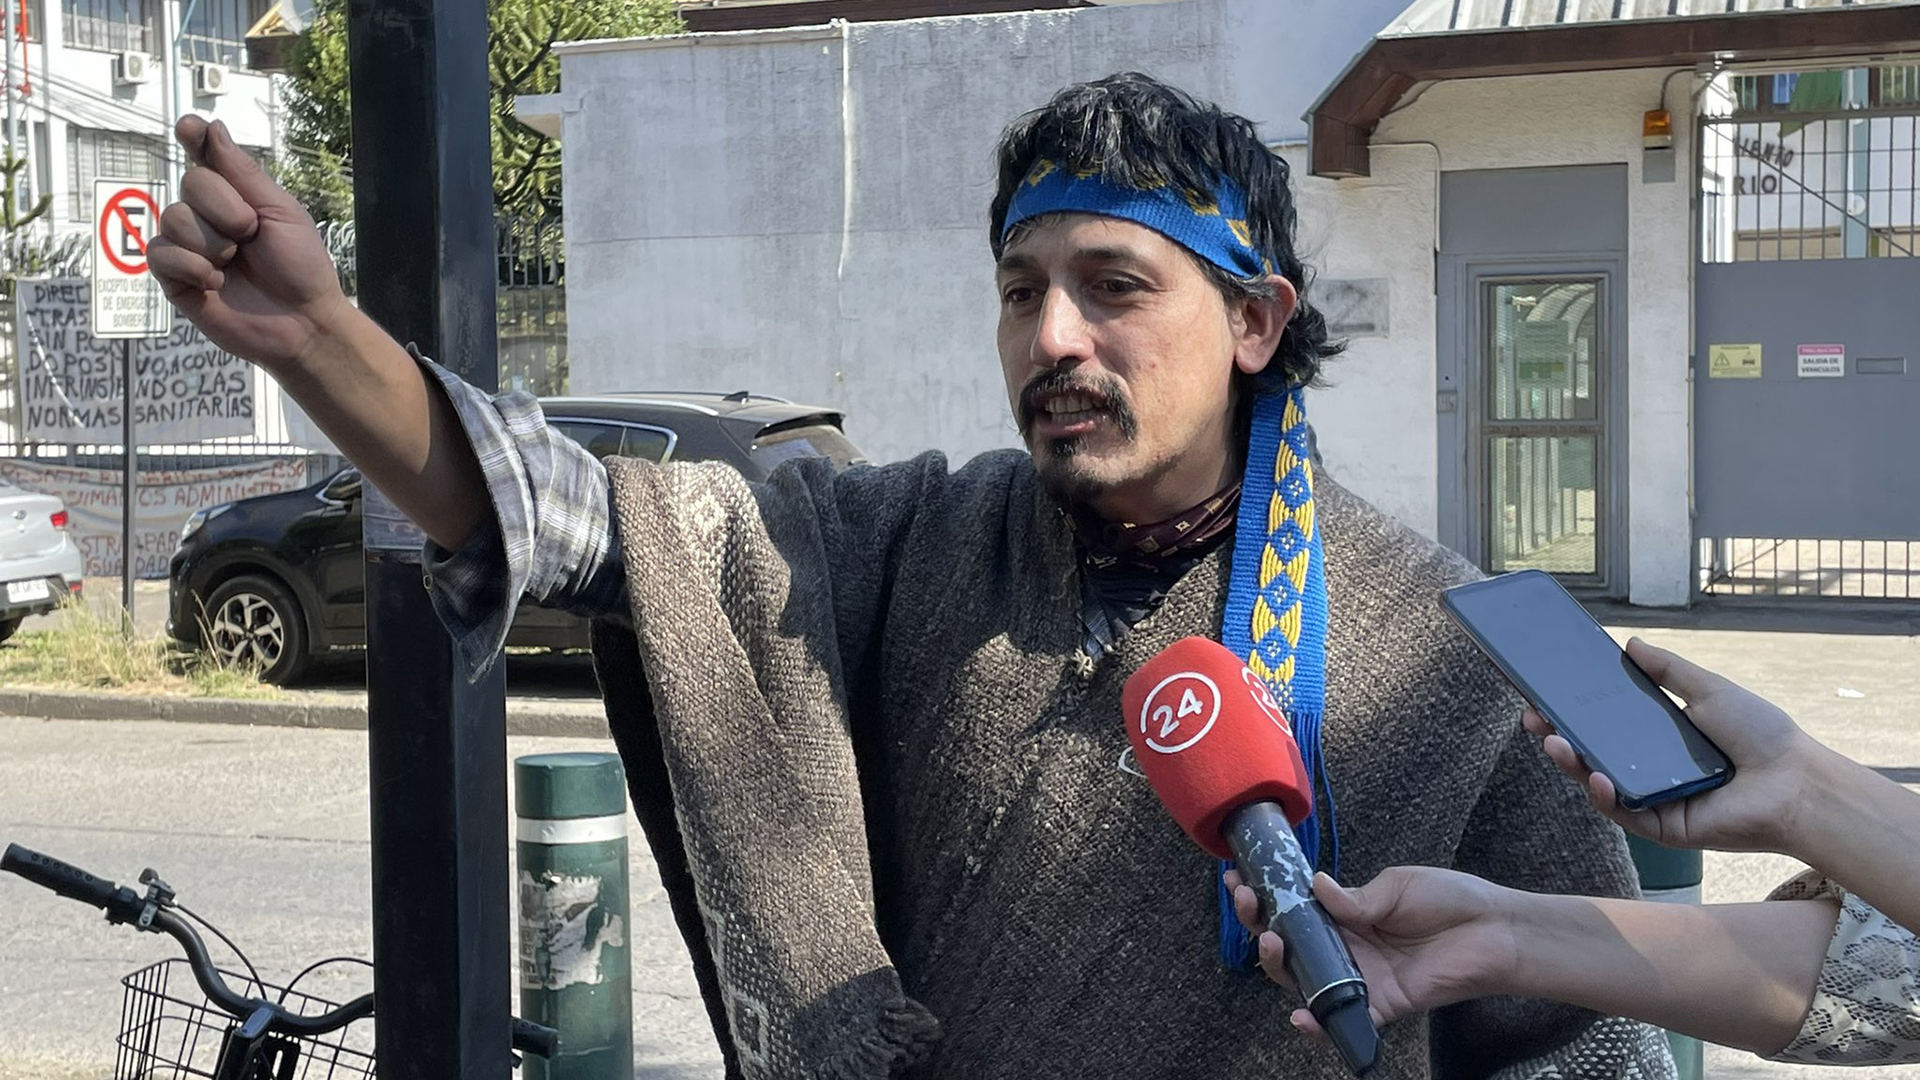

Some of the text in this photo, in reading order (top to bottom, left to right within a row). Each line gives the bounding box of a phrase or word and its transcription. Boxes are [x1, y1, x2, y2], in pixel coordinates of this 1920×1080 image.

[121, 207, 147, 256] E
[34, 285, 90, 304] DIREC
[98, 278, 129, 293] EXCEPTO
[103, 296, 114, 311] DE
[28, 330, 66, 350] SIN
[136, 325, 205, 354] RESUL
[197, 370, 247, 397] LAS
[27, 394, 252, 431] NORMAS SANITARIAS
[1152, 688, 1204, 738] 24
